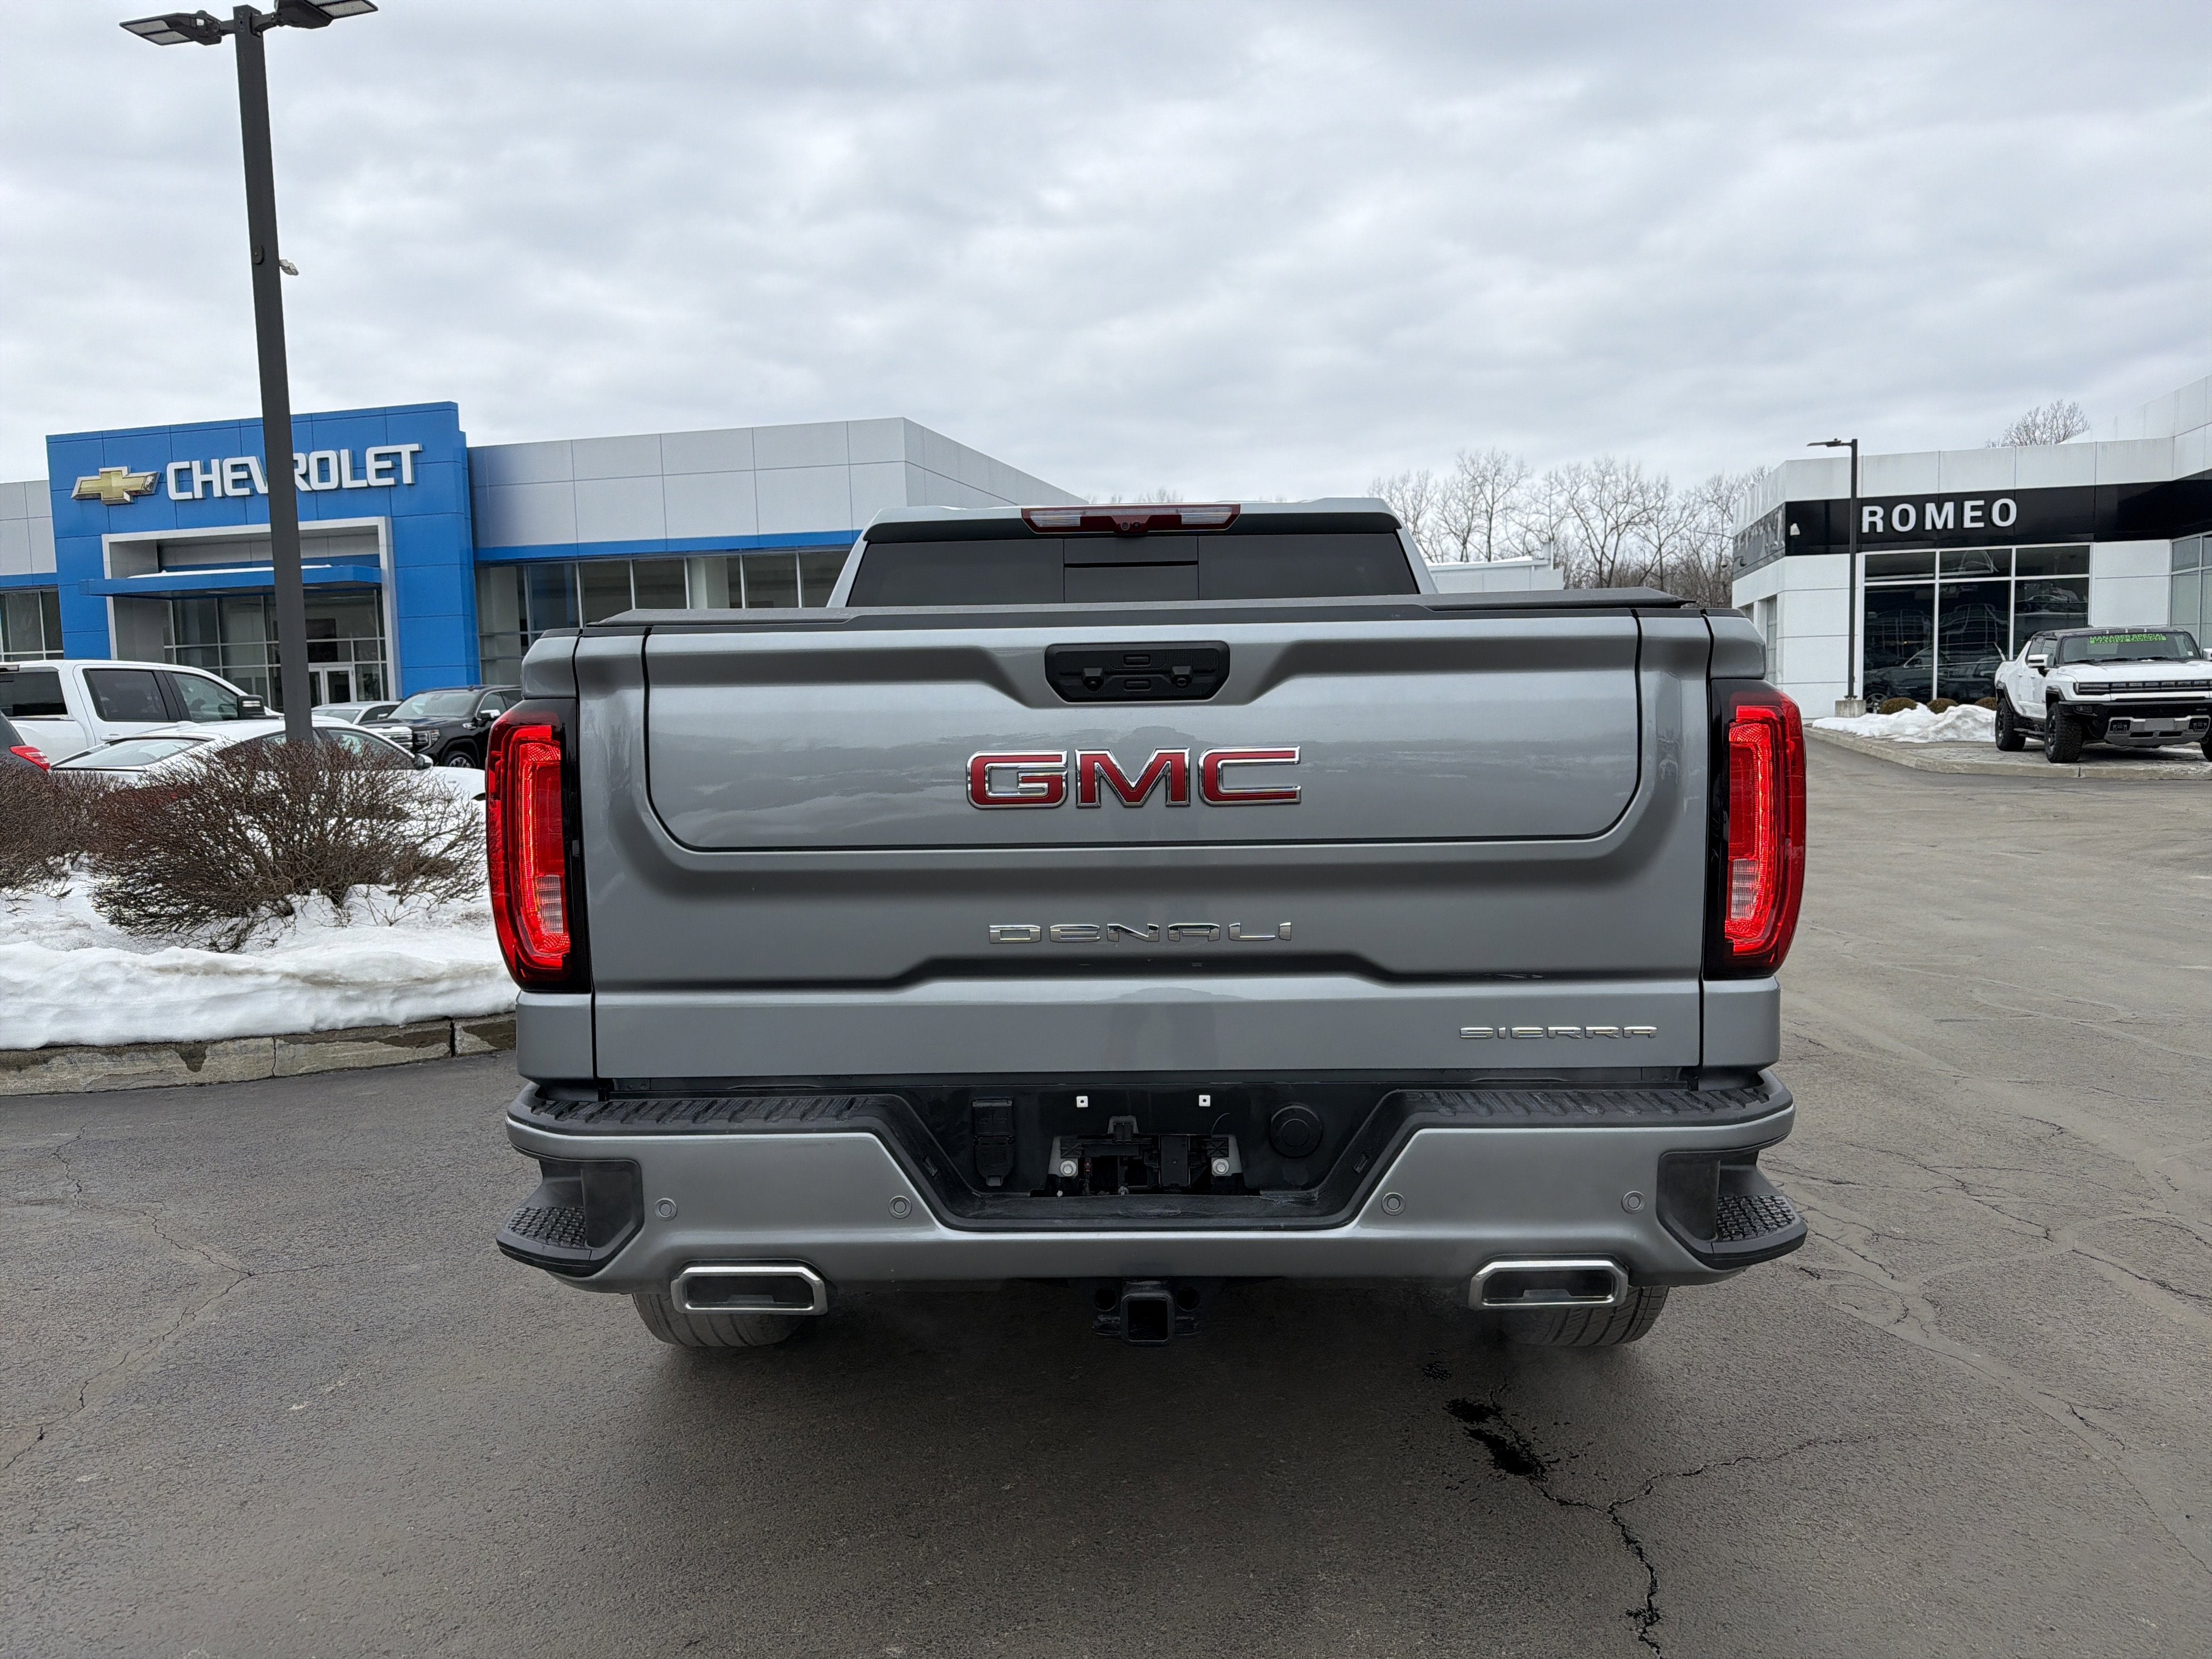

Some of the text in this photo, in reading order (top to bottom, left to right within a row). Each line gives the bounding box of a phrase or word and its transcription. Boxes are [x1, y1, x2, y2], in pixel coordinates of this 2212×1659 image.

[167, 443, 421, 500] CHEVROLET
[1861, 498, 2017, 533] ROMEO
[967, 746, 1301, 809] GMC
[989, 922, 1291, 943] DENALI
[1460, 1026, 1657, 1039] SIERRA
